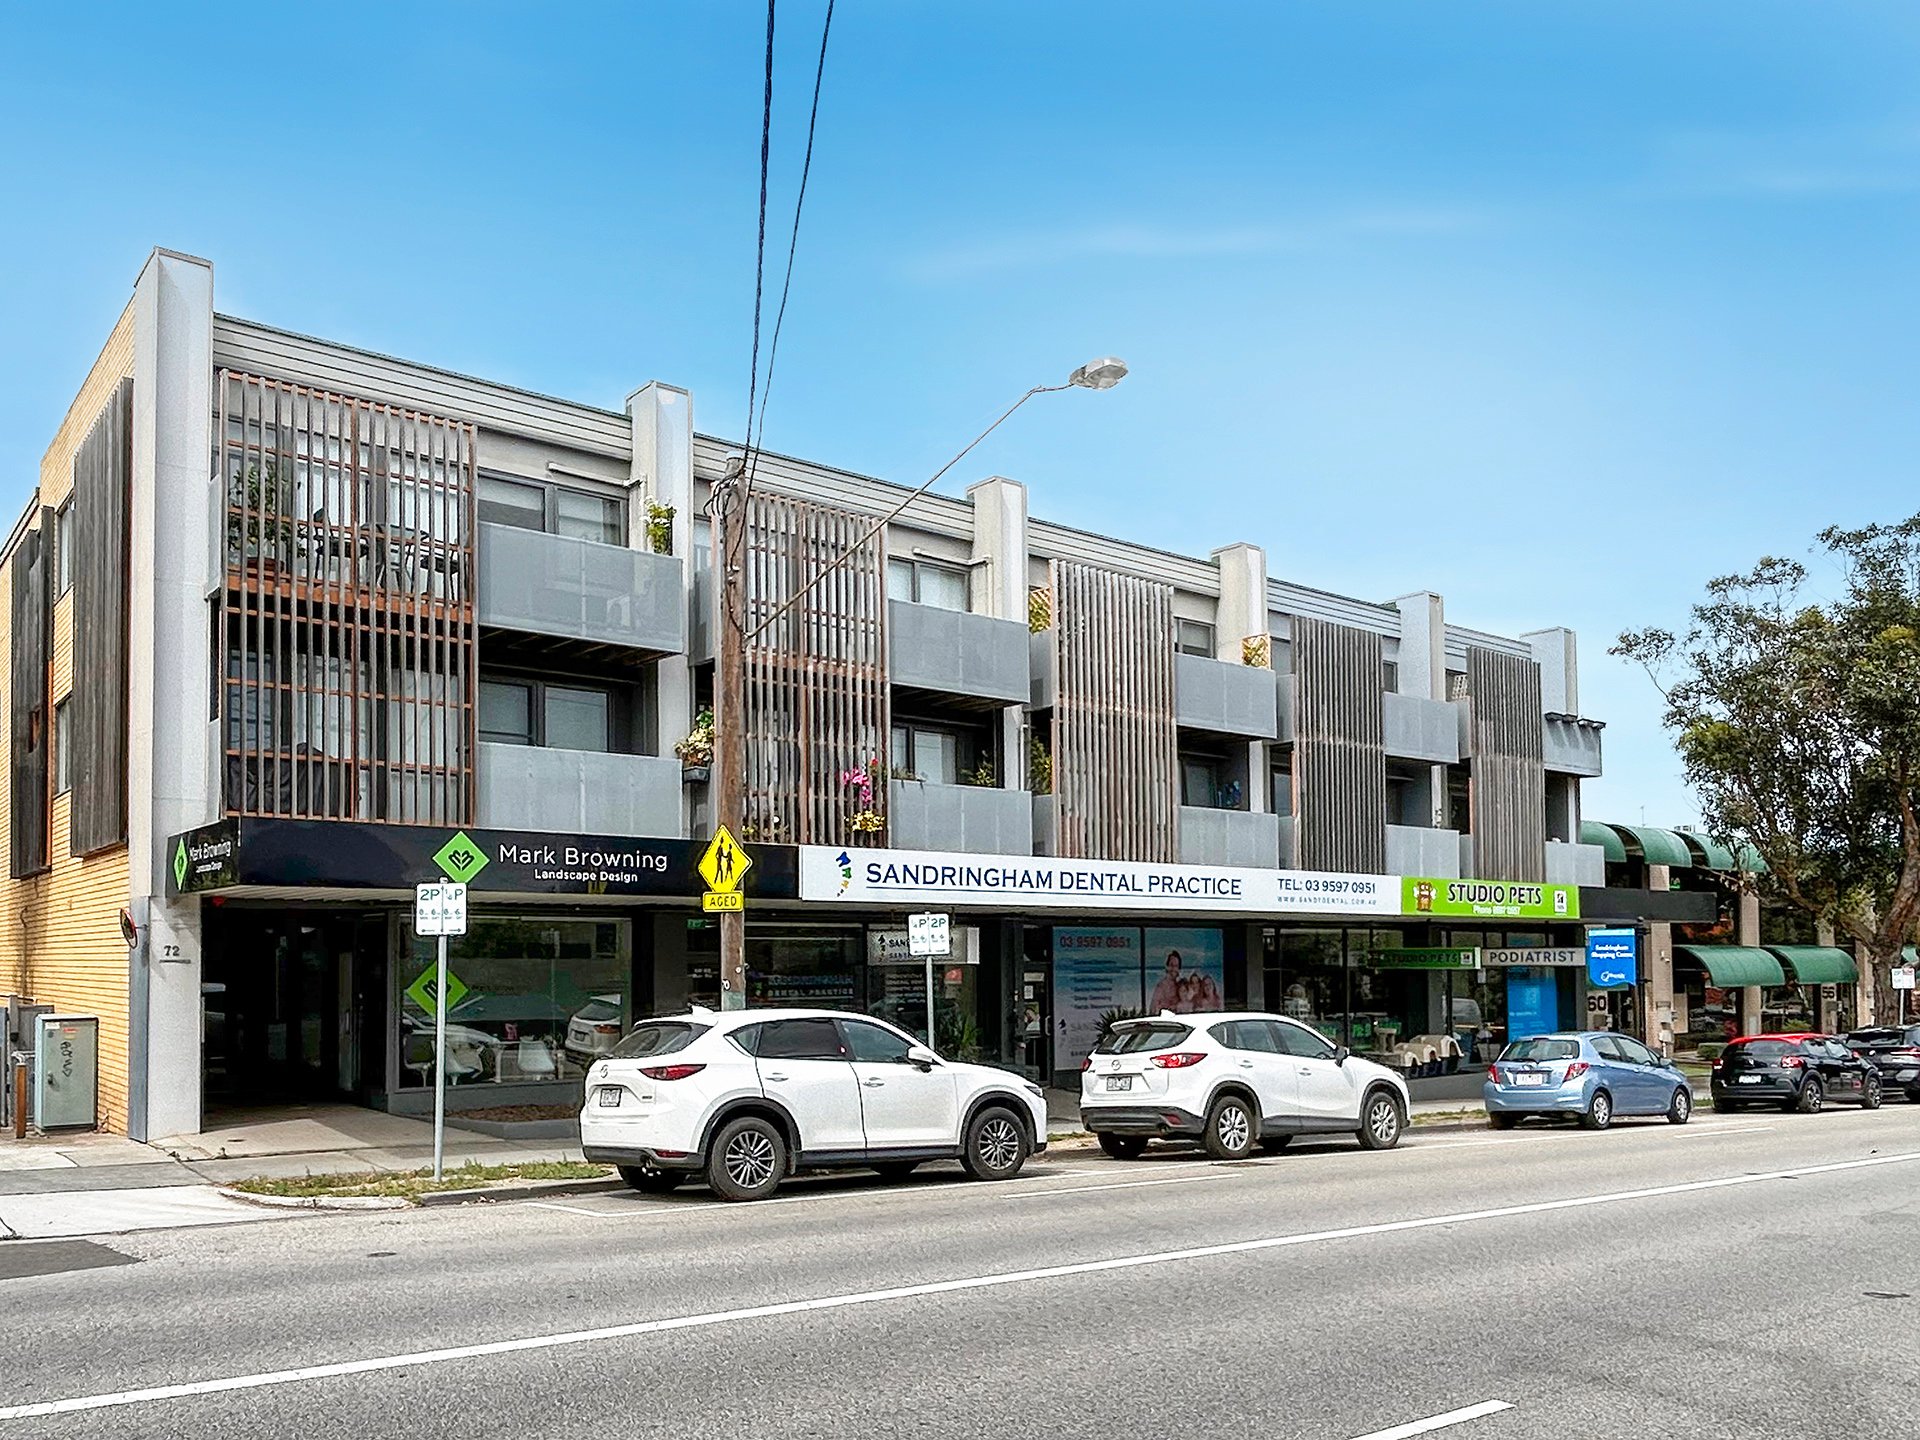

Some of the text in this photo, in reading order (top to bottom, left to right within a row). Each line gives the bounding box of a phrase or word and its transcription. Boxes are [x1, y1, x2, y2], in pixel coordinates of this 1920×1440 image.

[499, 844, 668, 872] Mark Browning
[534, 868, 638, 884] Landscape Design
[866, 862, 1242, 895] SANDRINGHAM DENTAL PRACTICE
[1277, 878, 1376, 894] TEL: 03 9597 0951
[420, 888, 440, 901] 2P
[1448, 883, 1542, 904] STUDIO PETS
[709, 896, 737, 907] AGED
[931, 918, 947, 928] 2P
[1060, 936, 1073, 948] 03
[164, 946, 180, 957] 72
[1490, 951, 1576, 963] PODIATRIST
[1588, 996, 1607, 1012] 60
